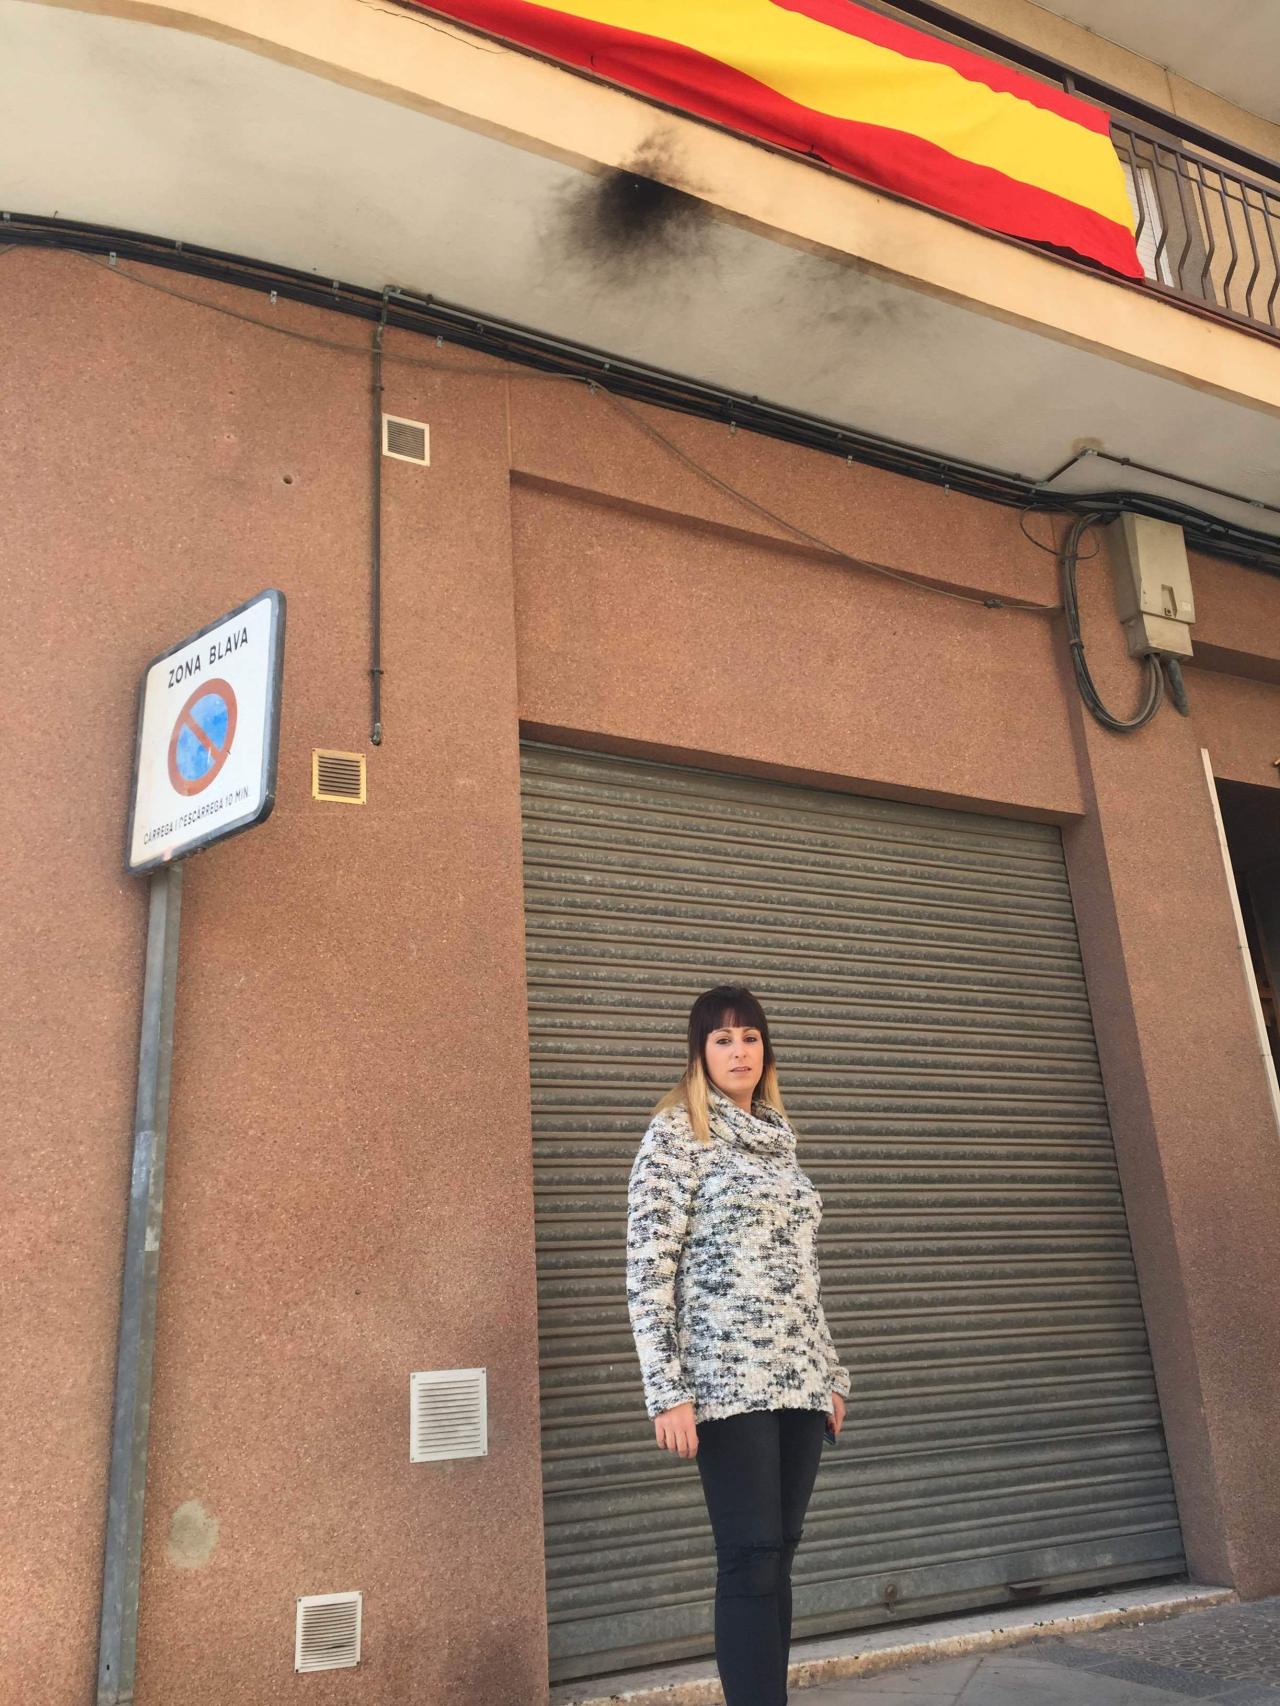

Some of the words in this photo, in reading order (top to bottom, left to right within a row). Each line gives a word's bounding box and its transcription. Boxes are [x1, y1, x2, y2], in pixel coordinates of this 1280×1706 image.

[168, 654, 201, 688] ZONA
[209, 626, 248, 664] BLAVA
[225, 793, 234, 807] 10
